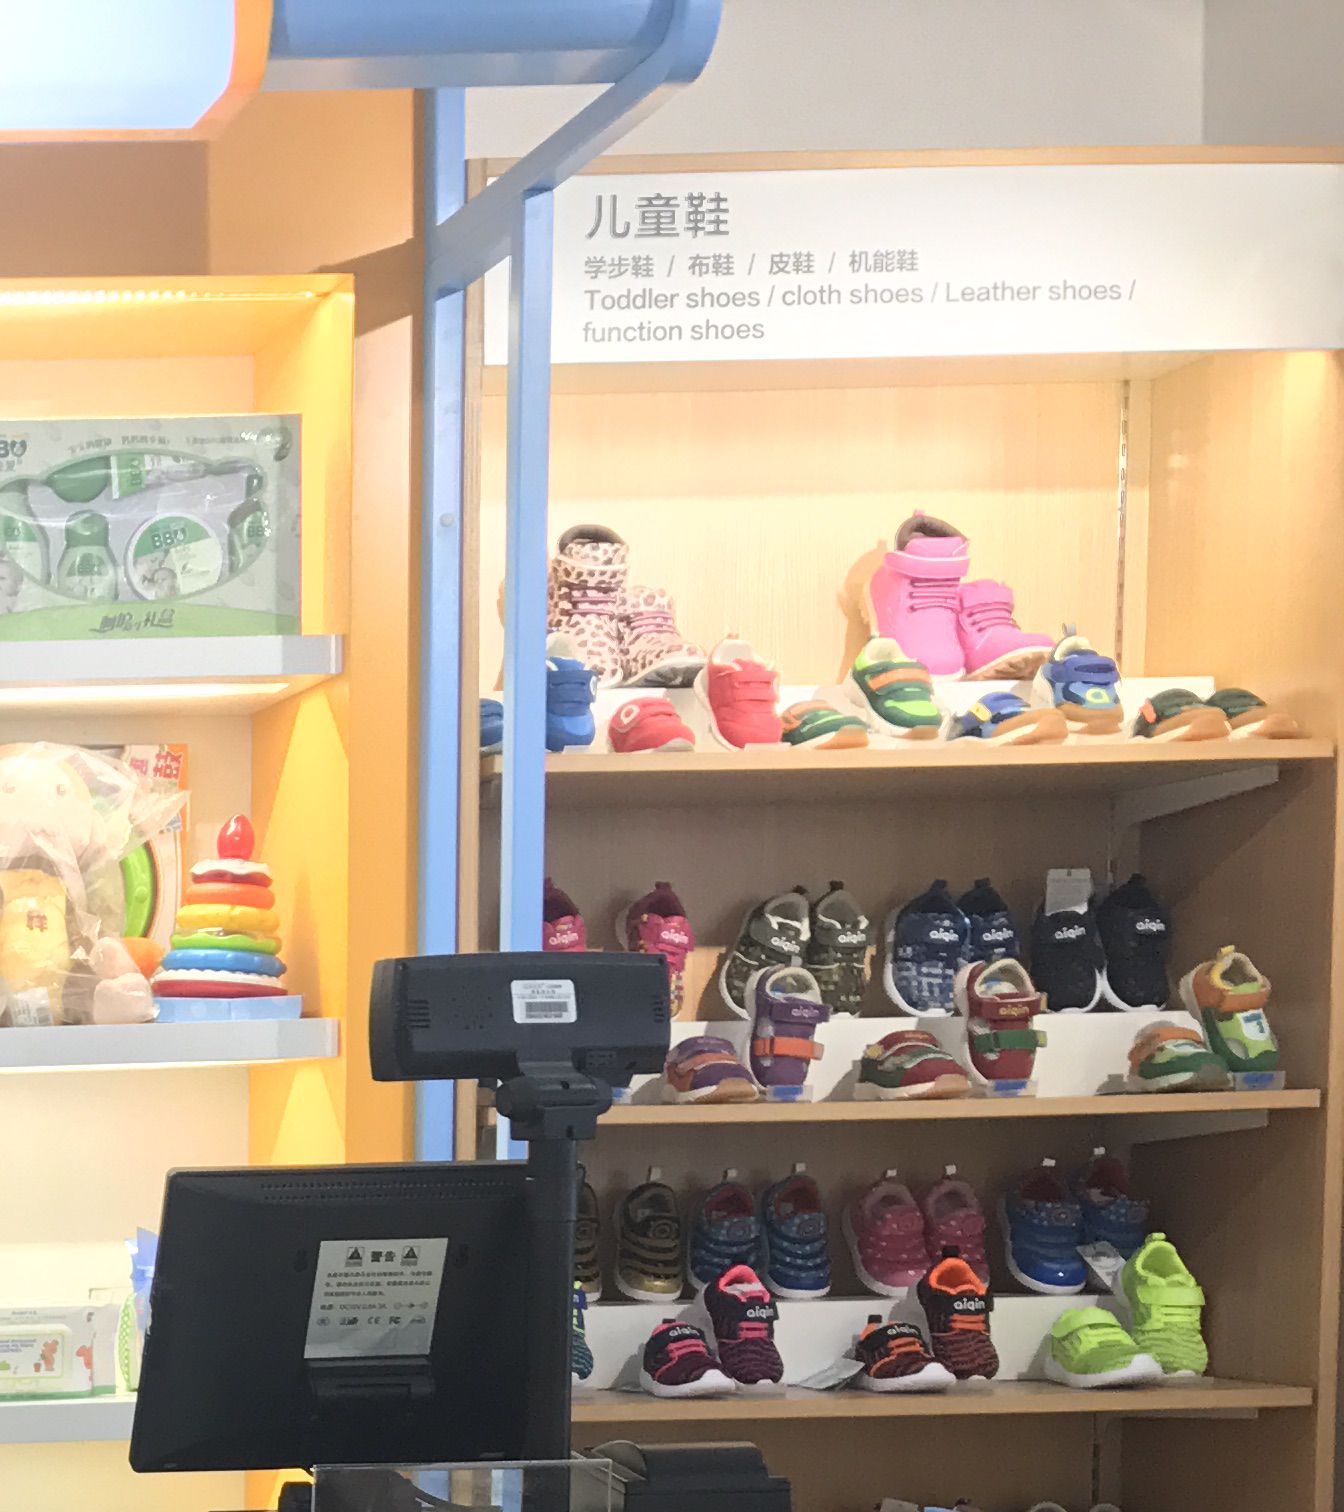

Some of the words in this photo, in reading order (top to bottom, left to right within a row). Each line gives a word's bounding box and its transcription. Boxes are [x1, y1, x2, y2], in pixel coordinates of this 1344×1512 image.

[585, 193, 731, 241] 儿童鞋
[584, 254, 655, 280] 学步鞋
[688, 254, 736, 279] 布鞋
[768, 251, 816, 276] 皮鞋
[848, 249, 920, 275] 机能鞋
[584, 286, 680, 312] Toddler
[685, 285, 761, 310] shoes
[782, 283, 842, 307] cloth
[849, 282, 924, 305] shoes
[946, 279, 1039, 304] Leather
[1048, 278, 1122, 302] shoes
[583, 319, 683, 345] function
[690, 317, 765, 342] shoes
[661, 929, 689, 945] aiqin
[929, 928, 960, 943] aiqin
[1054, 925, 1086, 940] aiqin
[746, 1305, 776, 1321] aiqin
[954, 1297, 986, 1313] aiqin
